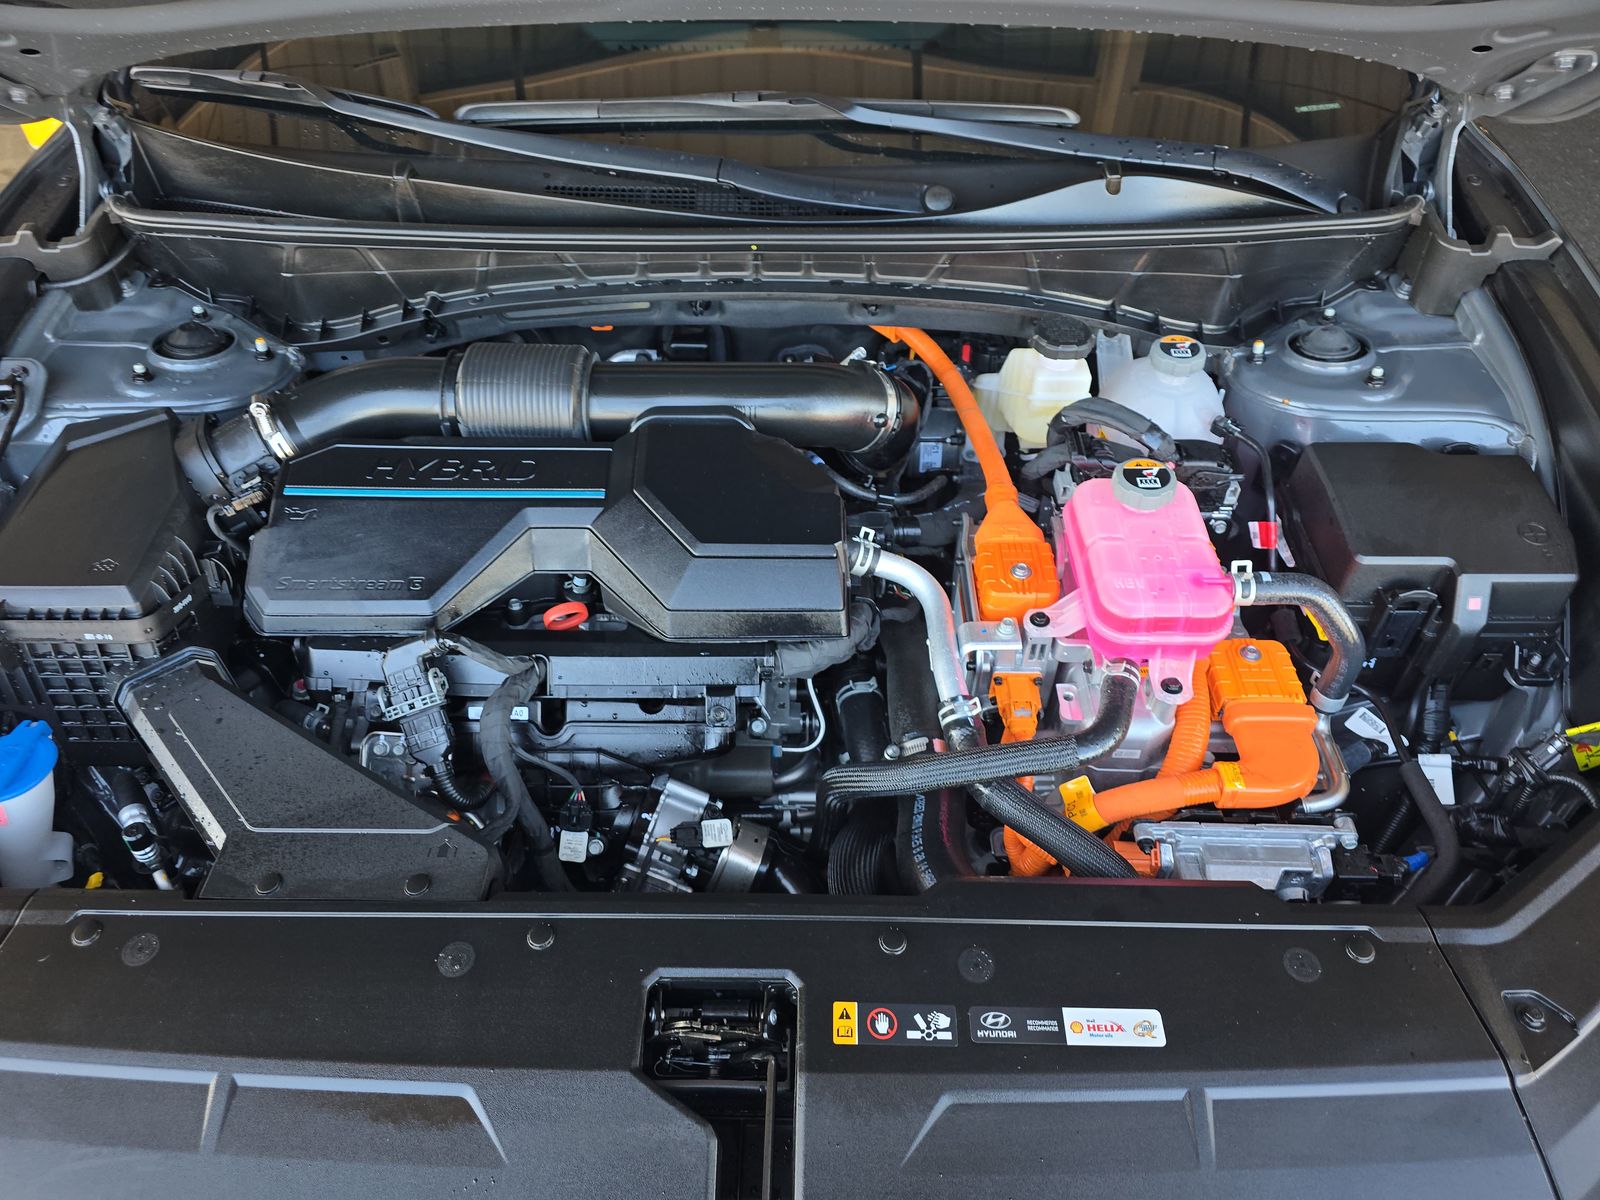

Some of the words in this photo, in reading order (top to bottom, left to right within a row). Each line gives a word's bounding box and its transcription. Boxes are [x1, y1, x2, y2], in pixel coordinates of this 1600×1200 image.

[365, 457, 537, 482] HYBRID
[274, 576, 405, 592] Smartstream
[977, 1029, 1017, 1038] HYUNDAI
[1087, 1023, 1124, 1032] HELIX
